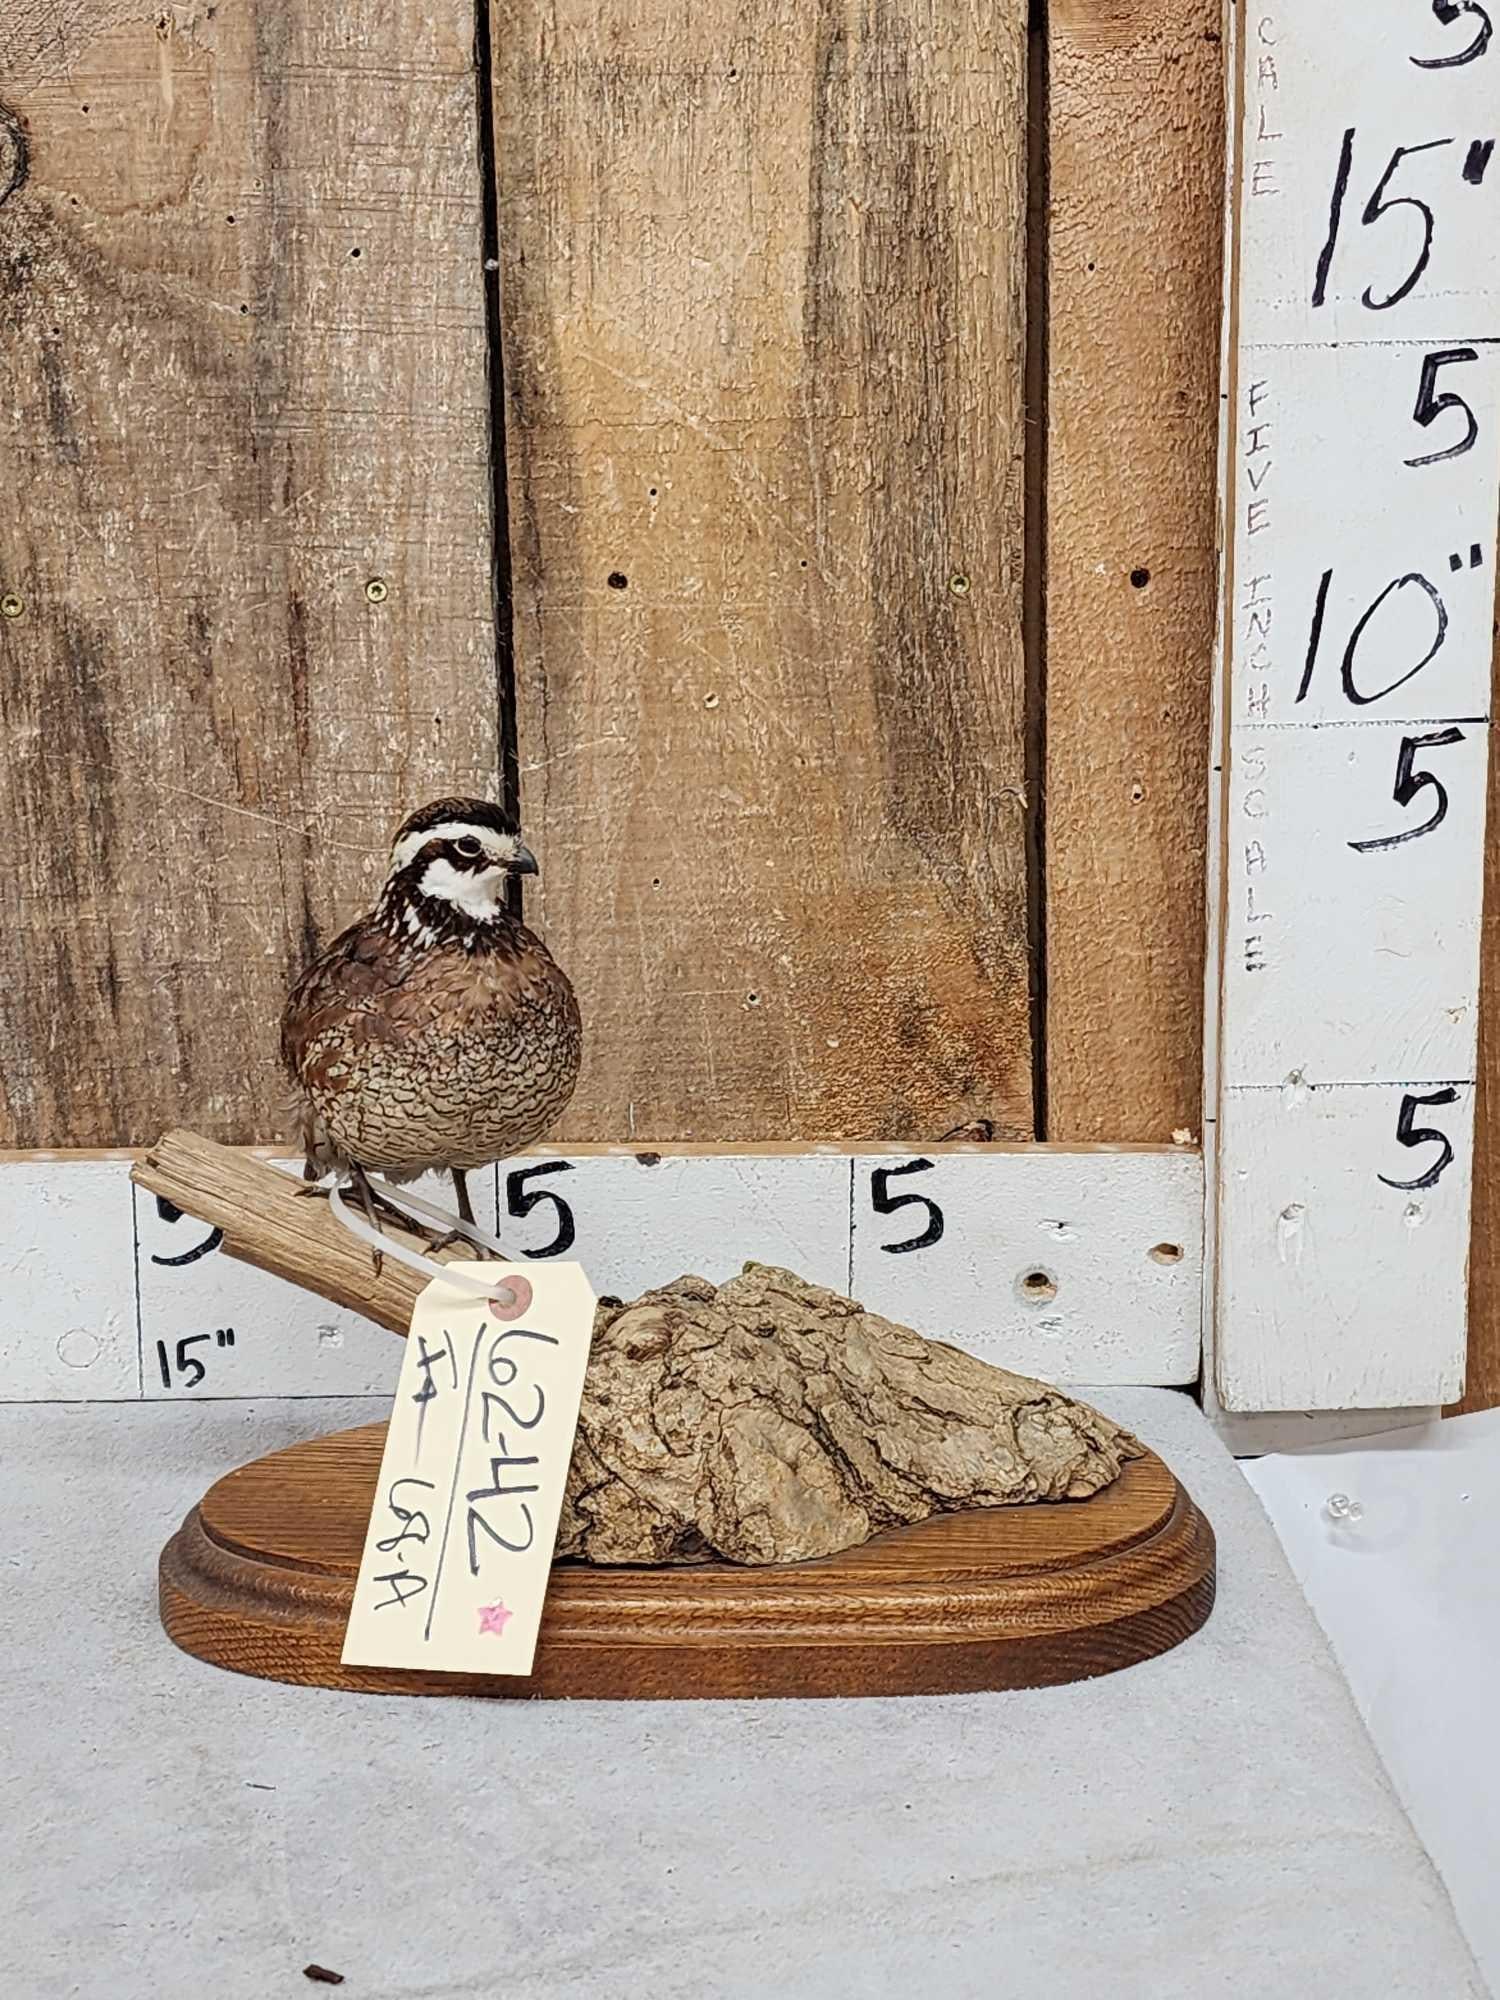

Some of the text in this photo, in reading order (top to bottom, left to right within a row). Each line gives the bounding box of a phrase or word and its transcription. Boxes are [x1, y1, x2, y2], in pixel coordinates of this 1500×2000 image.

[1251, 16, 1284, 197] CALE
[1402, 347, 1479, 468] 5
[1240, 379, 1273, 972] FIVE INCH SCALE
[1346, 726, 1467, 854] 5
[1376, 1086, 1461, 1191] 5
[505, 1159, 577, 1260] 5
[869, 1157, 945, 1255] 5
[466, 1328, 560, 1577] 62-42
